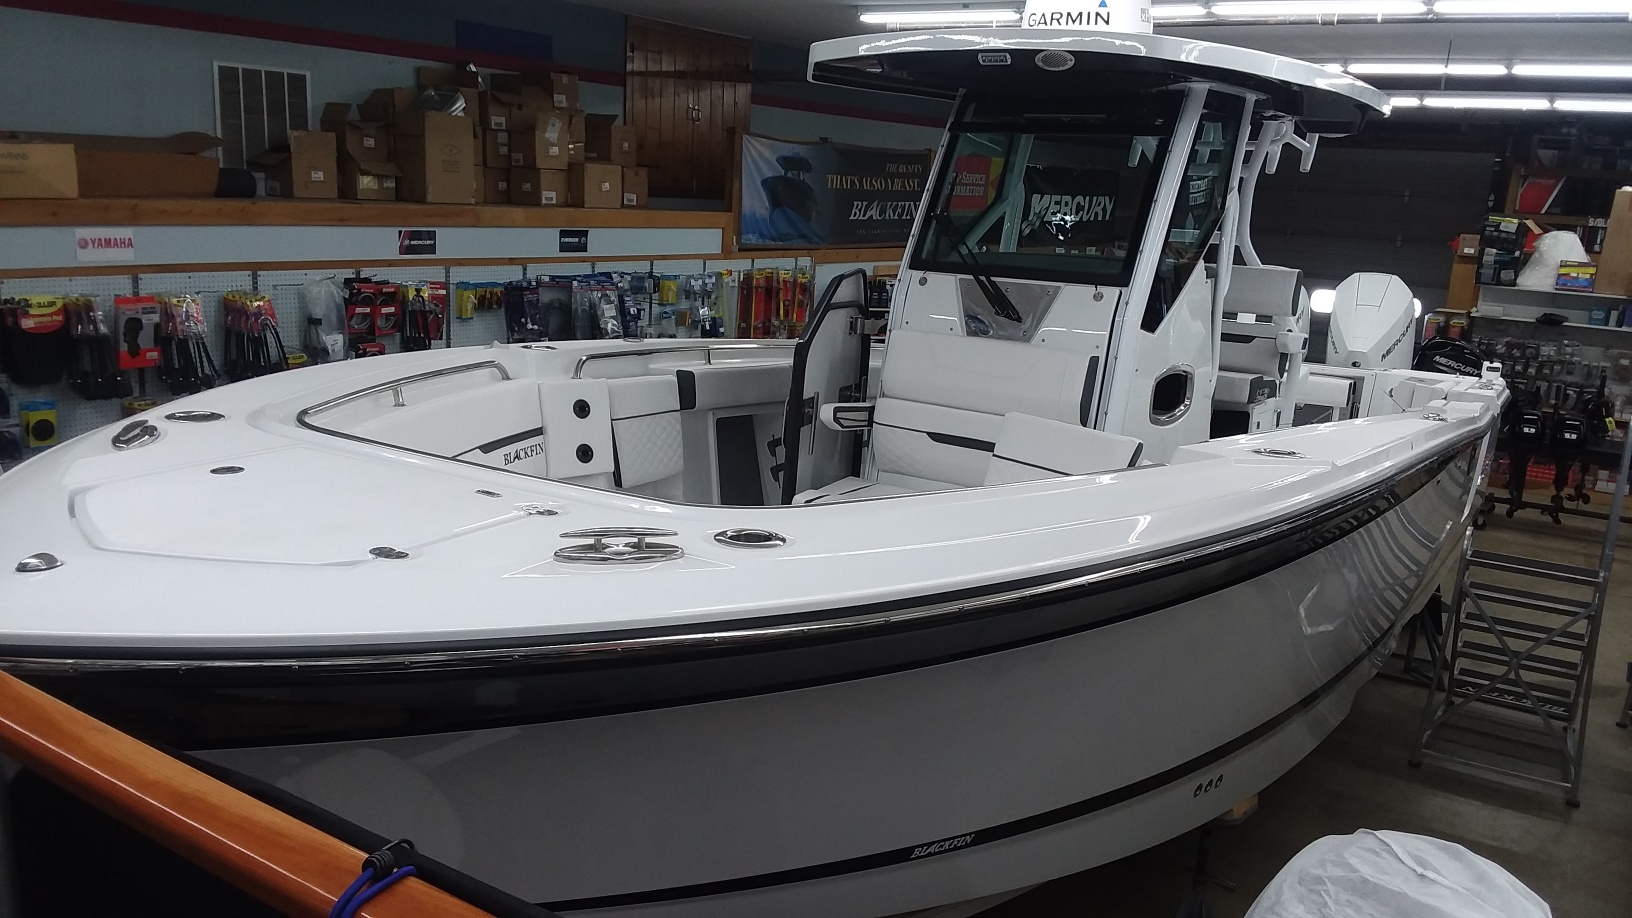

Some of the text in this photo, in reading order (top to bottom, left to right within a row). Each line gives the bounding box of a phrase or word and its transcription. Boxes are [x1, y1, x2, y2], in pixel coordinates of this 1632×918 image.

[1027, 11, 1110, 27] GARMIN
[826, 174, 860, 190] THAT'S
[862, 176, 885, 191] ALSO
[849, 199, 920, 220] BLACKFIN
[1026, 193, 1115, 226] MERCURY
[90, 237, 134, 249] YAMAHA
[1380, 318, 1413, 363] MERCURY
[1433, 354, 1482, 376] MERCURY
[503, 441, 544, 467] BLACKFIN
[909, 833, 976, 859] BLACKFIN
